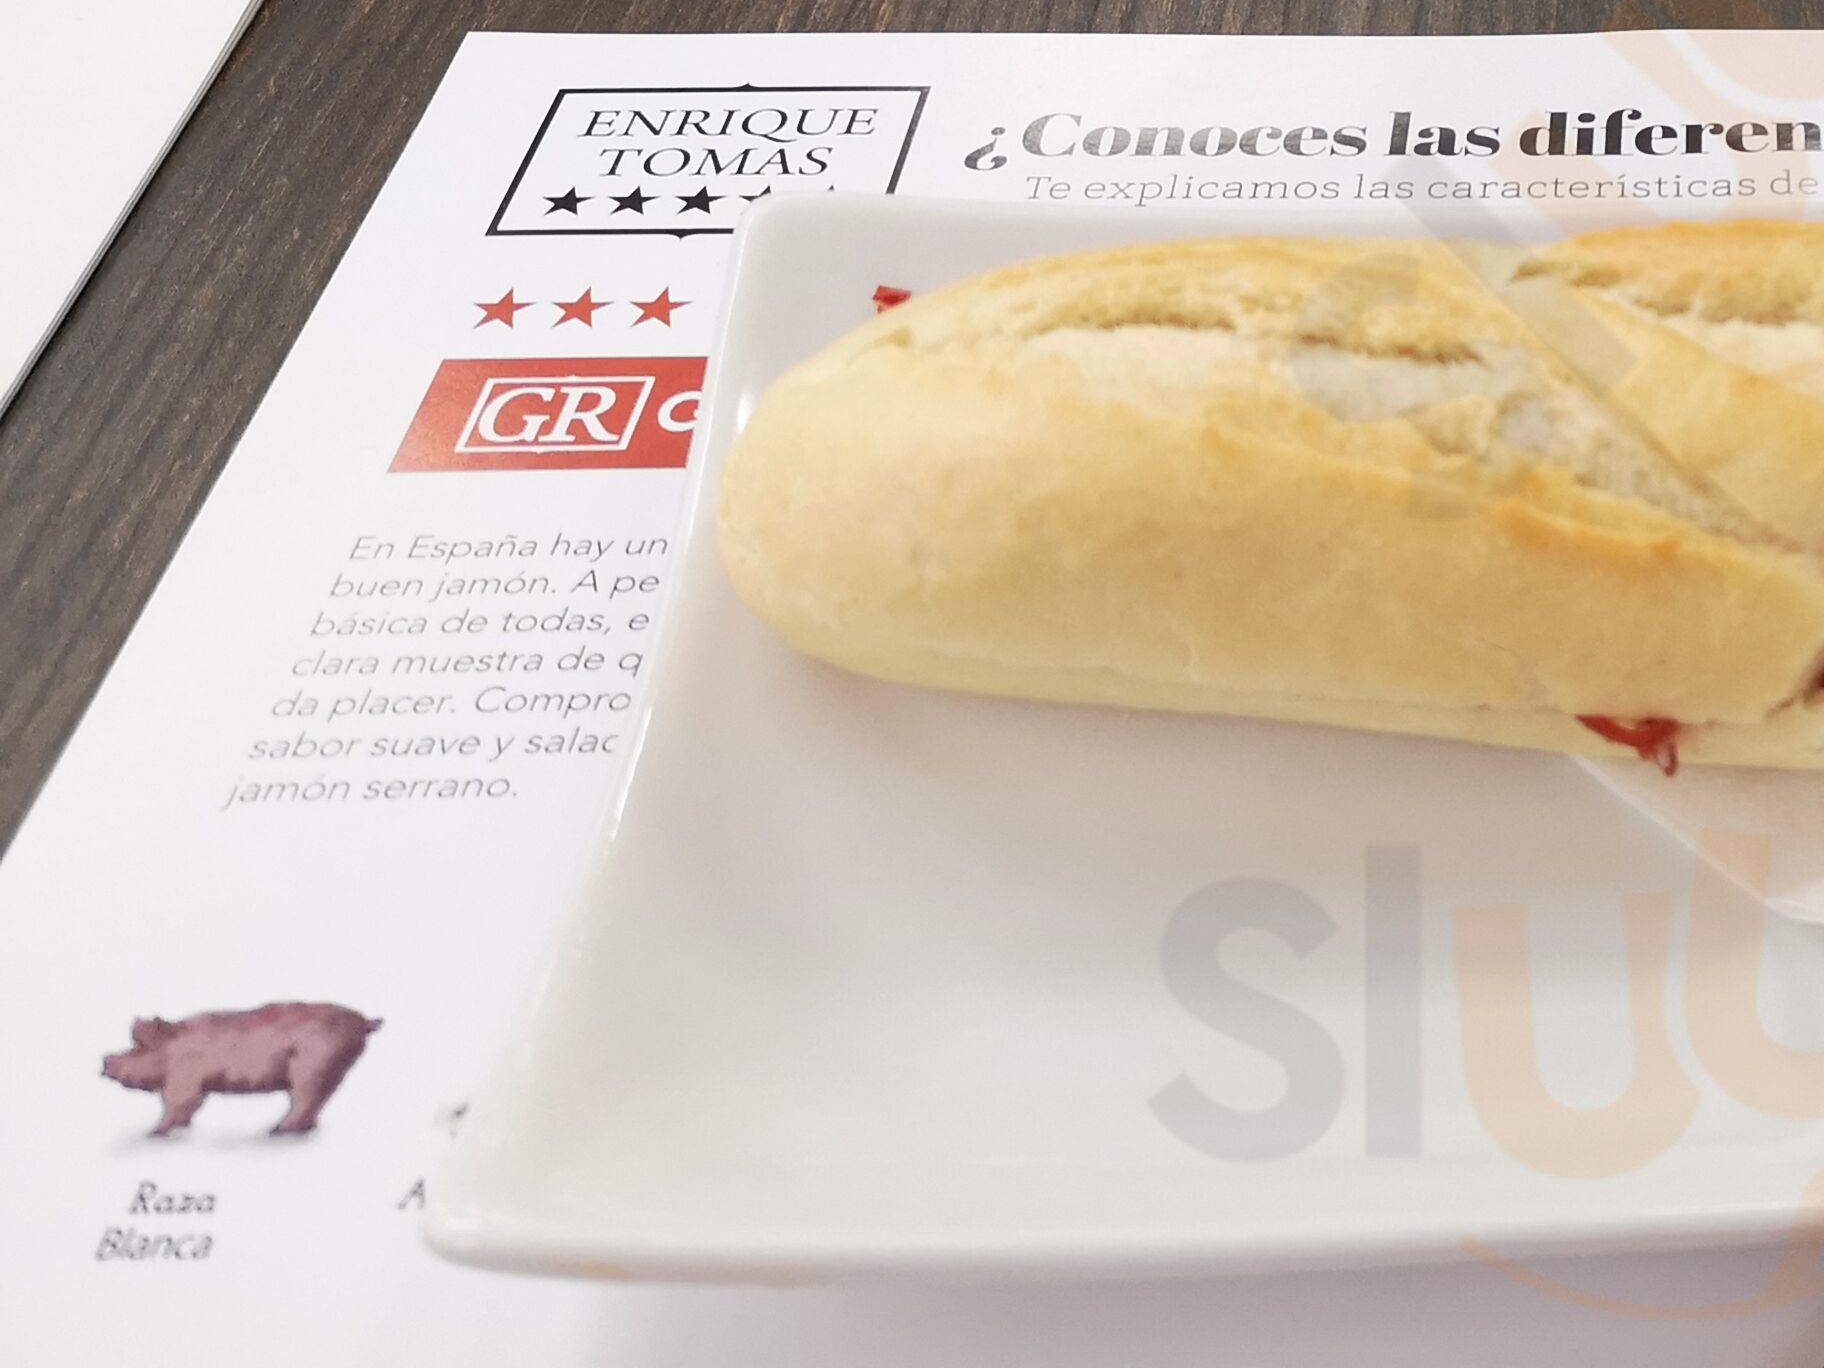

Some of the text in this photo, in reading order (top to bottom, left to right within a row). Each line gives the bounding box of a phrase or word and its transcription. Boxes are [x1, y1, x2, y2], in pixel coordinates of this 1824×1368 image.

[577, 107, 879, 143] ENRIQUE
[963, 111, 1368, 171] ¿Conoces
[1384, 110, 1502, 158] las
[1025, 175, 1072, 200] Te
[1083, 173, 1340, 208] explicamos
[1353, 173, 1415, 200] las
[1427, 172, 1757, 200] características
[1769, 168, 1819, 196] de
[477, 385, 621, 443] GR
[349, 532, 669, 564] En España hay un
[329, 573, 424, 598] buen
[428, 571, 557, 603] jamón.
[570, 569, 599, 594] A
[309, 611, 428, 637] básica
[440, 608, 489, 633] de
[501, 606, 612, 635] todas,
[291, 649, 380, 676] clara
[390, 651, 545, 674] muestra
[556, 644, 605, 672] de
[270, 685, 633, 723] da placer. Compro
[247, 730, 362, 761] sabor
[369, 734, 481, 757] suave
[487, 733, 516, 762] y
[220, 773, 519, 812] jamón serrano.
[128, 1180, 218, 1216] Raza
[95, 1226, 215, 1263] Blanca
